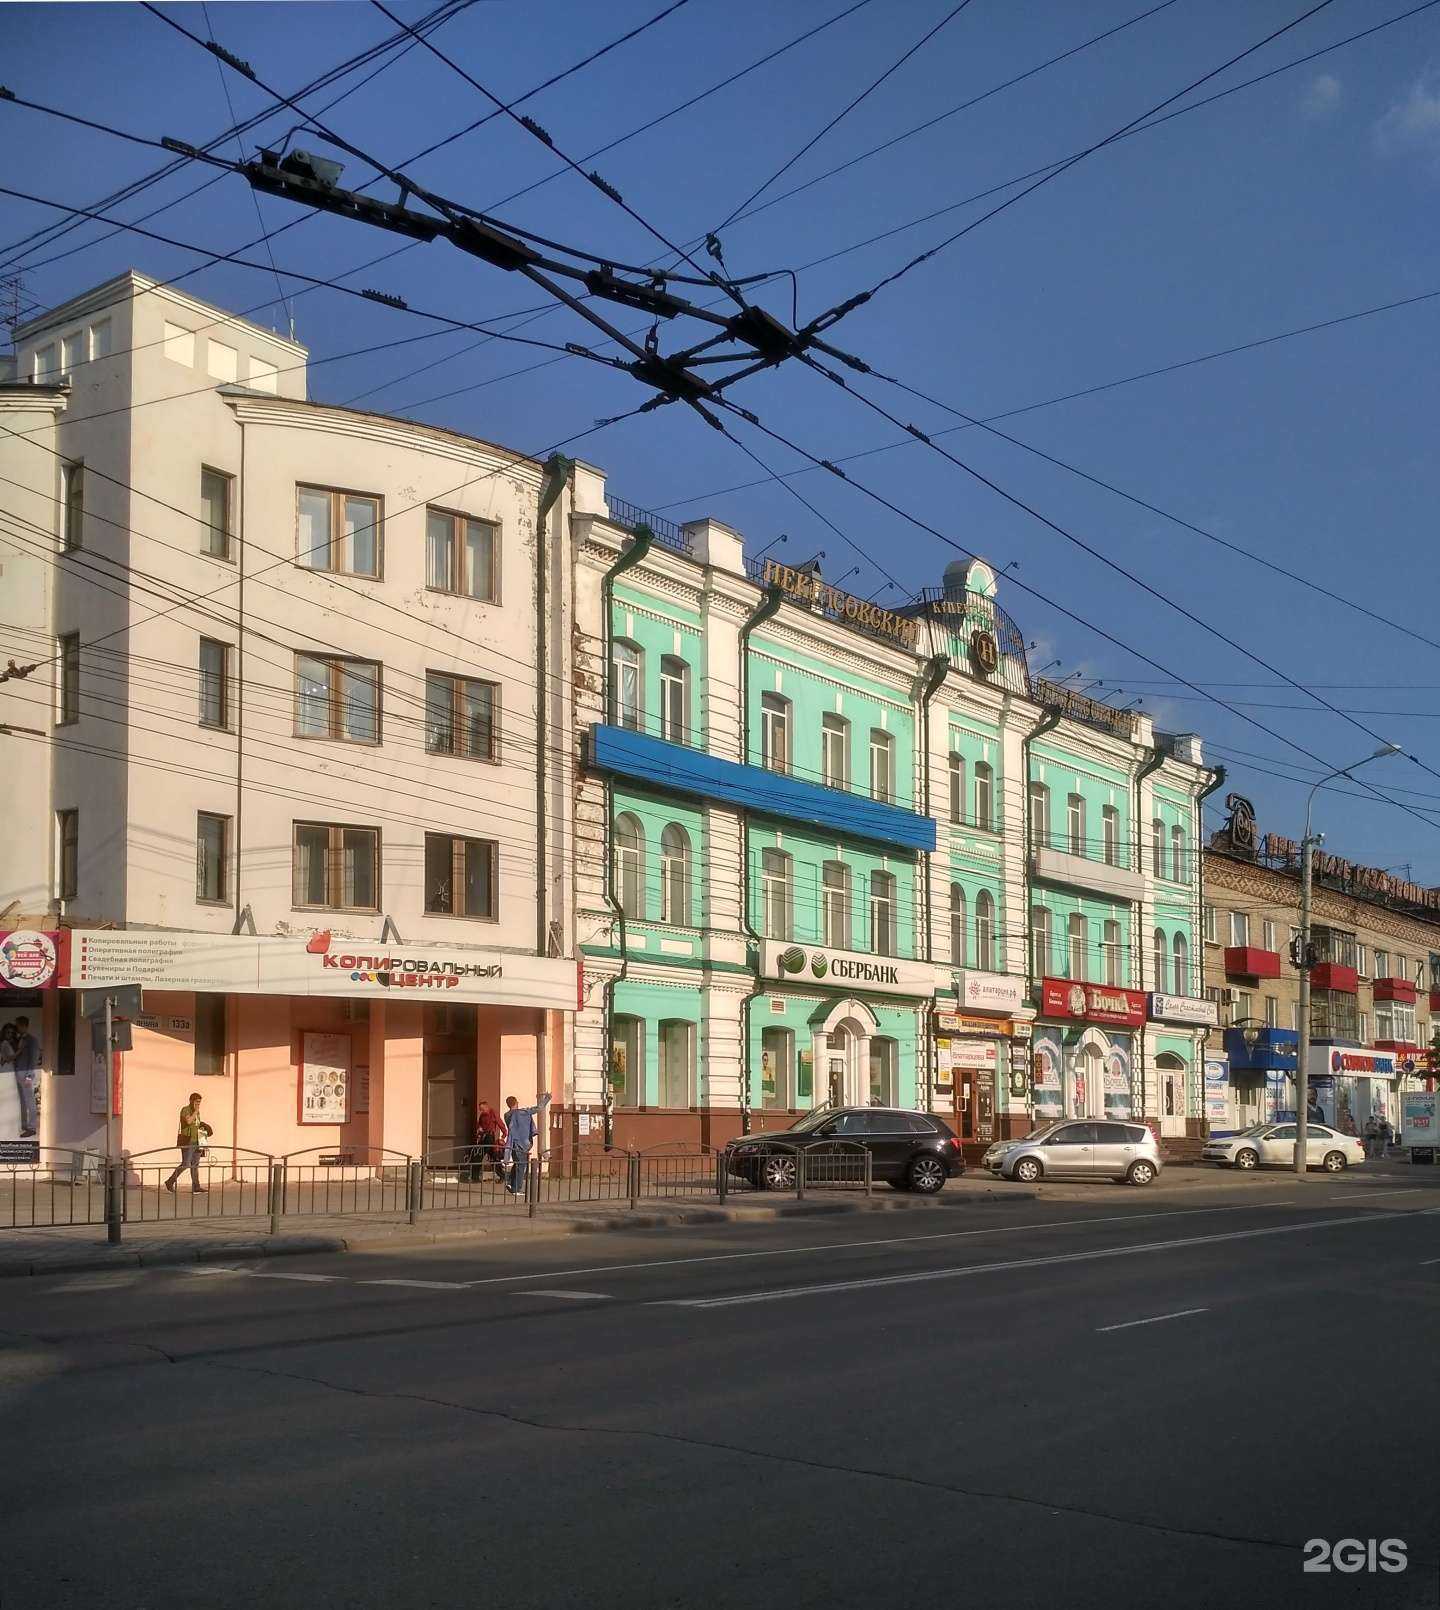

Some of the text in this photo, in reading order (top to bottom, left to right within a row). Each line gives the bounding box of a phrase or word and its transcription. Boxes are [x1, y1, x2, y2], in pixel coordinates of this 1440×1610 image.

[323, 954, 503, 978] КОПИРОВАЛЬНЫЙ
[831, 958, 899, 985] СБЕРБАНК
[389, 972, 460, 989] ЦЕНТР
